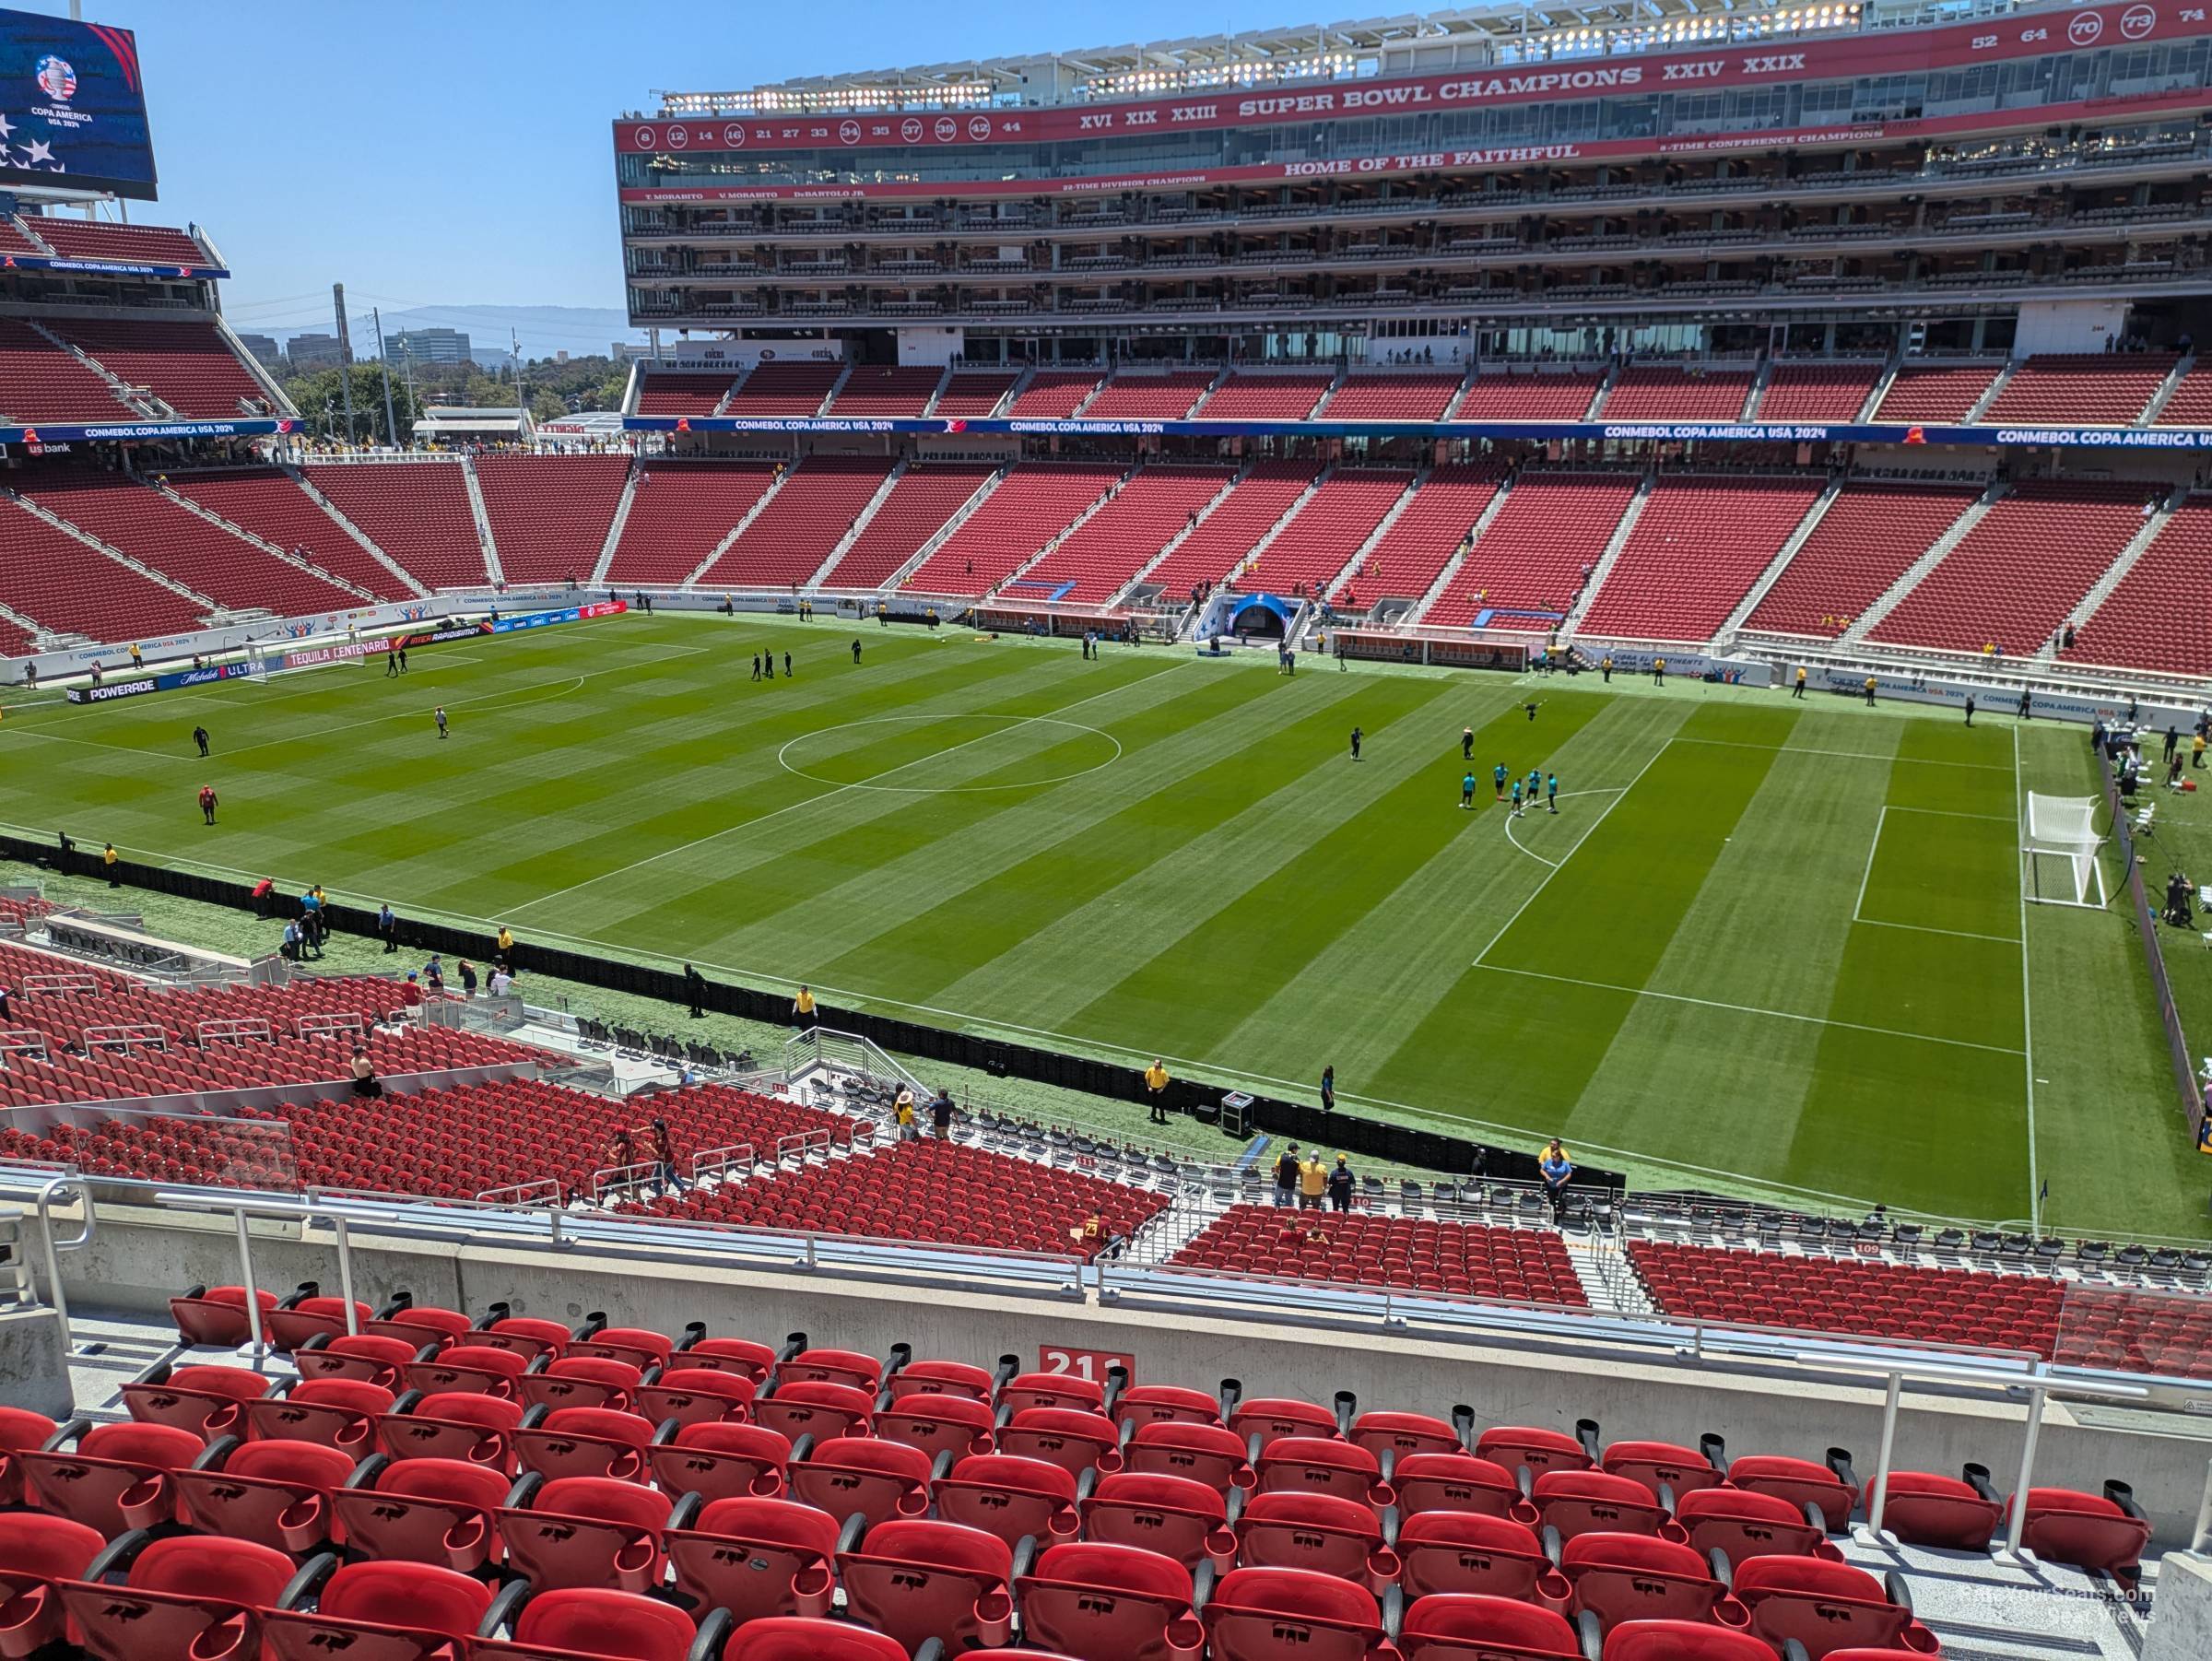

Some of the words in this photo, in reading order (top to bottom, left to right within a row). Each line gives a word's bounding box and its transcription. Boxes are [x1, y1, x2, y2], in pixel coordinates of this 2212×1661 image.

[2179, 8, 2205, 22] 74
[2073, 21, 2099, 36] 70
[2124, 15, 2151, 29] 73
[1971, 35, 1997, 49] 52
[2020, 29, 2048, 42] 64
[1742, 53, 1806, 74] XXIX
[1662, 61, 1724, 80] XXIV
[1239, 94, 1334, 116] SUPER
[1342, 87, 1431, 108] BOWL
[1439, 66, 1641, 100] CHAMPIONS
[31, 107, 54, 117] COPA
[55, 111, 93, 123] AMERICA
[1125, 111, 1157, 125] XIX
[1171, 105, 1217, 122] XXIII
[48, 118, 62, 126] USA
[63, 120, 79, 128] 2024
[1003, 122, 1021, 132] 44
[1080, 113, 1112, 129] XVI
[727, 131, 742, 139] 16
[756, 130, 771, 138] 21
[782, 129, 799, 137] 27
[810, 128, 828, 137] 33
[841, 127, 858, 136] 34
[903, 125, 920, 135] 37
[971, 124, 989, 133] 42
[641, 133, 650, 141] 8
[670, 132, 685, 141] 12
[699, 132, 713, 140] 14
[1708, 135, 1795, 149] CONFERENCE
[1798, 130, 1884, 144] CHAMPIONS
[1285, 159, 1351, 177] HOME
[1359, 157, 1389, 171] OF
[1395, 153, 1444, 169] THE
[1453, 145, 1580, 165] FAITHFUL
[1100, 180, 1145, 189] DIVISION
[1147, 175, 1206, 186] CHAMPIONS
[50, 261, 84, 270] CONMEBOL
[85, 263, 100, 271] COPA
[101, 264, 127, 272] AMERICA
[85, 427, 135, 438] CONMEBOL
[135, 426, 161, 437] COPA
[160, 426, 197, 436] AMERICA
[198, 425, 214, 435] USA
[215, 424, 234, 434] 2024
[735, 420, 785, 430] CONMEBOL
[785, 420, 811, 430] COPA
[811, 420, 849, 430] AMERICA
[853, 421, 870, 430] USA
[871, 421, 893, 430] 2024
[1010, 422, 1058, 431] CONMEBOL
[1058, 422, 1081, 431] COPA
[1082, 422, 1122, 432] AMERICA
[1123, 422, 1140, 432] USA
[1141, 423, 1164, 433] 2024
[1605, 426, 1673, 438] CONMEBOL
[1673, 427, 1709, 438] COPA
[1709, 427, 1765, 439] AMERICA
[1768, 427, 1793, 439] USA
[1794, 427, 1827, 439] 2024
[1996, 430, 2078, 444] CONMEBOL
[2080, 430, 2123, 444] COPA
[2123, 432, 2195, 446] AMERICA
[44, 442, 71, 453] bank
[79, 648, 115, 660] CONMEBOL
[140, 642, 162, 651] MERICA
[162, 639, 174, 647] USA
[175, 638, 190, 646] 2024
[290, 649, 330, 666] TEQUILA
[334, 639, 390, 658] CENTENARIO
[1652, 656, 1703, 666] CNTINENTE
[181, 669, 218, 685] Michelob
[228, 662, 265, 676] ULTRA
[89, 679, 155, 701] POWERADE
[1983, 694, 2022, 706] CONMEB
[2031, 701, 2054, 710] COPA
[2055, 703, 2096, 714] AMERICA
[2098, 708, 2115, 717] USA
[2117, 710, 2139, 719] 204
[773, 1084, 787, 1093] 112
[1077, 1157, 1092, 1166] 111
[1350, 1197, 1369, 1206] 110
[1085, 1223, 1098, 1236] 23
[1857, 1244, 1879, 1254] 109
